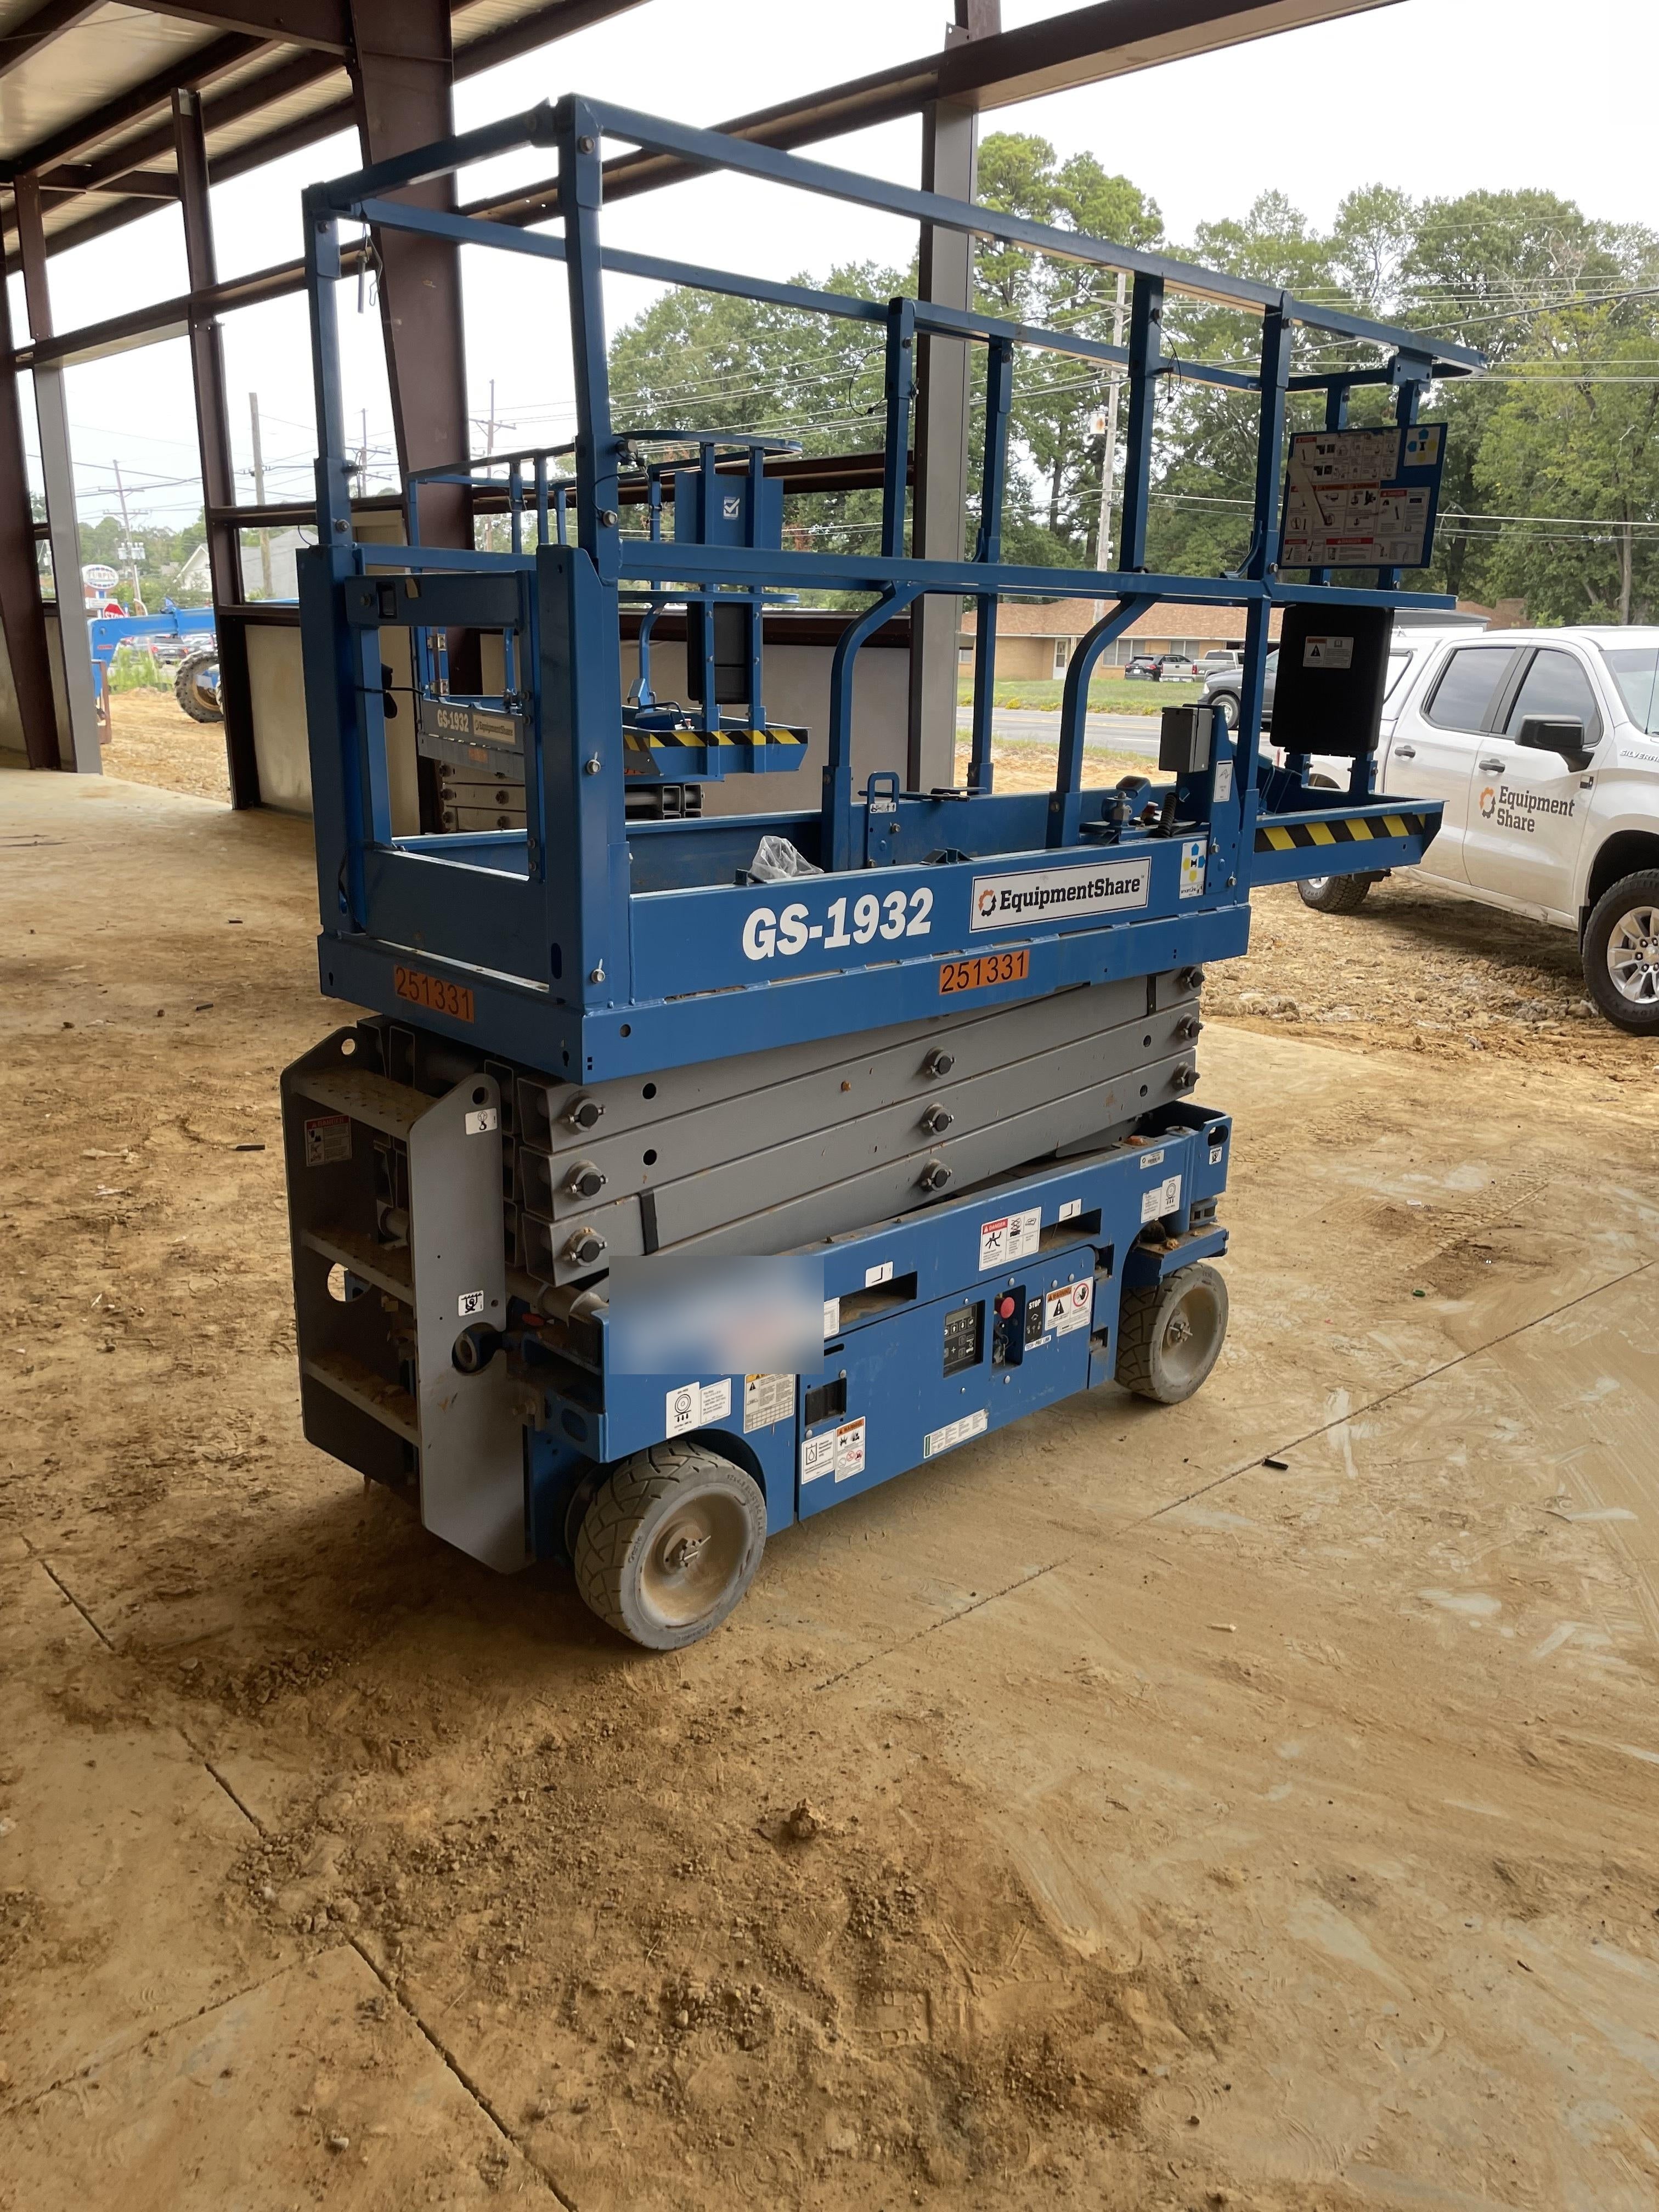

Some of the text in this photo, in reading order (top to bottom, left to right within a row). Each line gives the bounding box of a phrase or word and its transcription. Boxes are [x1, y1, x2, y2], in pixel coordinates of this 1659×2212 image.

[437, 709, 469, 733] GS-1932
[1499, 786, 1575, 817] Equipment
[1497, 808, 1535, 832] Share
[1000, 878, 1141, 912] EquipmentShare
[742, 887, 934, 961] GS-1932
[941, 951, 1024, 993] 251331
[396, 967, 469, 1019] 251331
[989, 1221, 1006, 1230] DANGER
[1029, 1299, 1041, 1310] STOP
